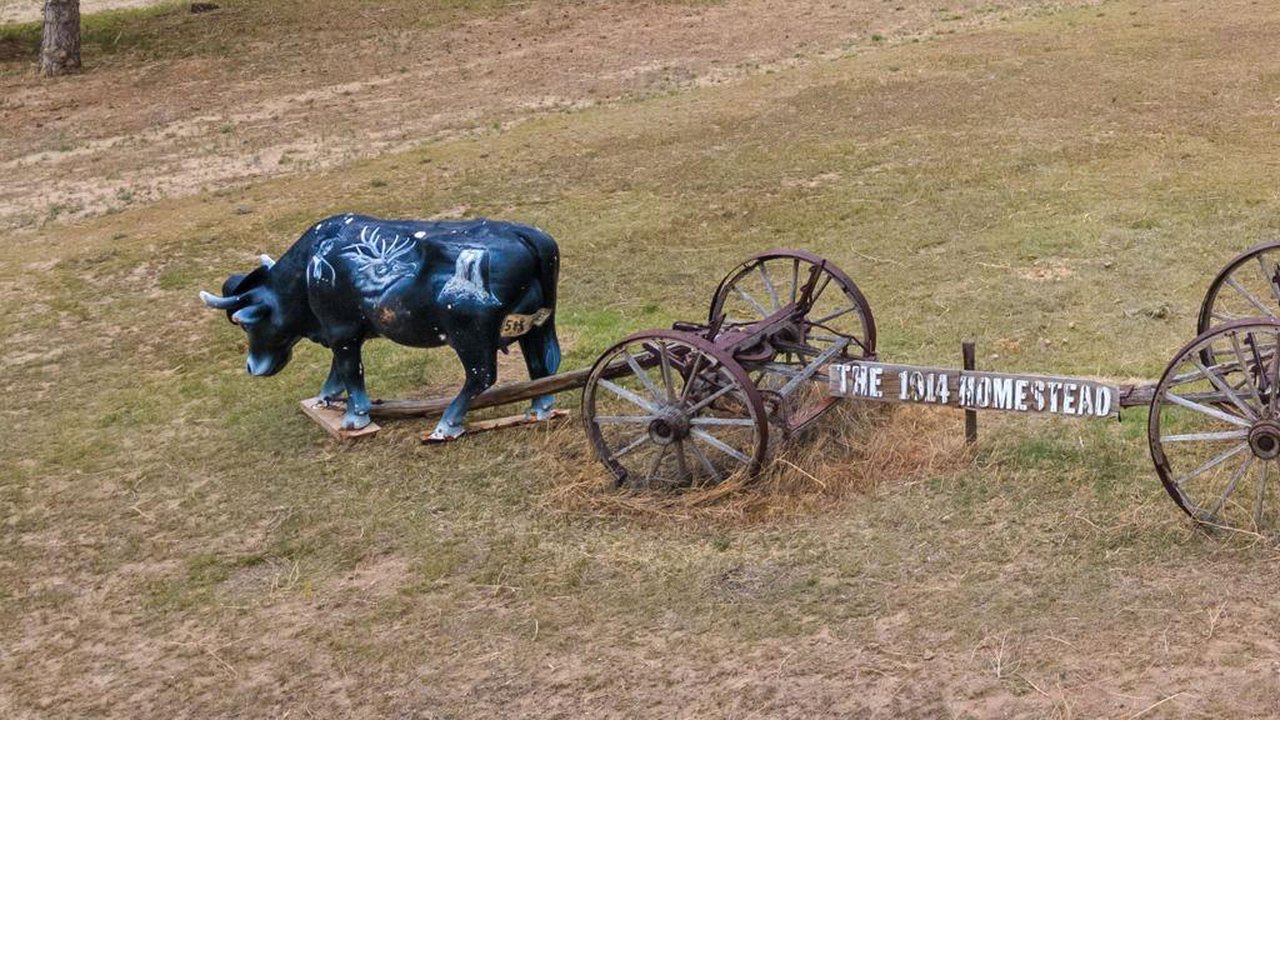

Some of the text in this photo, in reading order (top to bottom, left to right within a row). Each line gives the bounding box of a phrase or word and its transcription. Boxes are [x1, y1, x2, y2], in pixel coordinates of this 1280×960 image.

[837, 364, 1112, 417] THE 1914 HOMESTEAD
